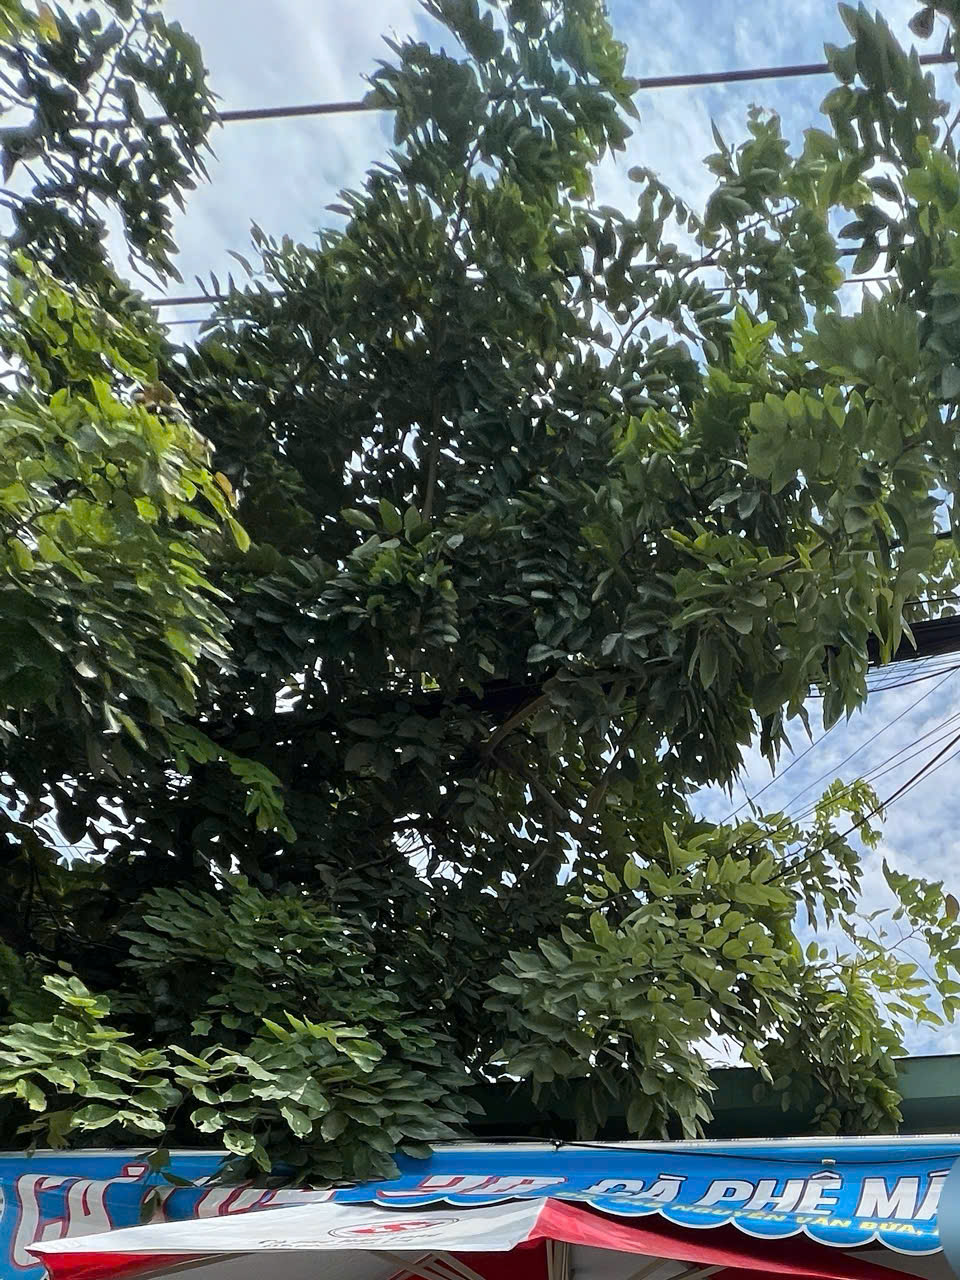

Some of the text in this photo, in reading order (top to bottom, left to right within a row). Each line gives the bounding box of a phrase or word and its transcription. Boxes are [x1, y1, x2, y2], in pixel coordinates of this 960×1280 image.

[583, 1173, 687, 1203] CÀ
[693, 1169, 843, 1217] PHÊ
[854, 1168, 943, 1221] MÁ
